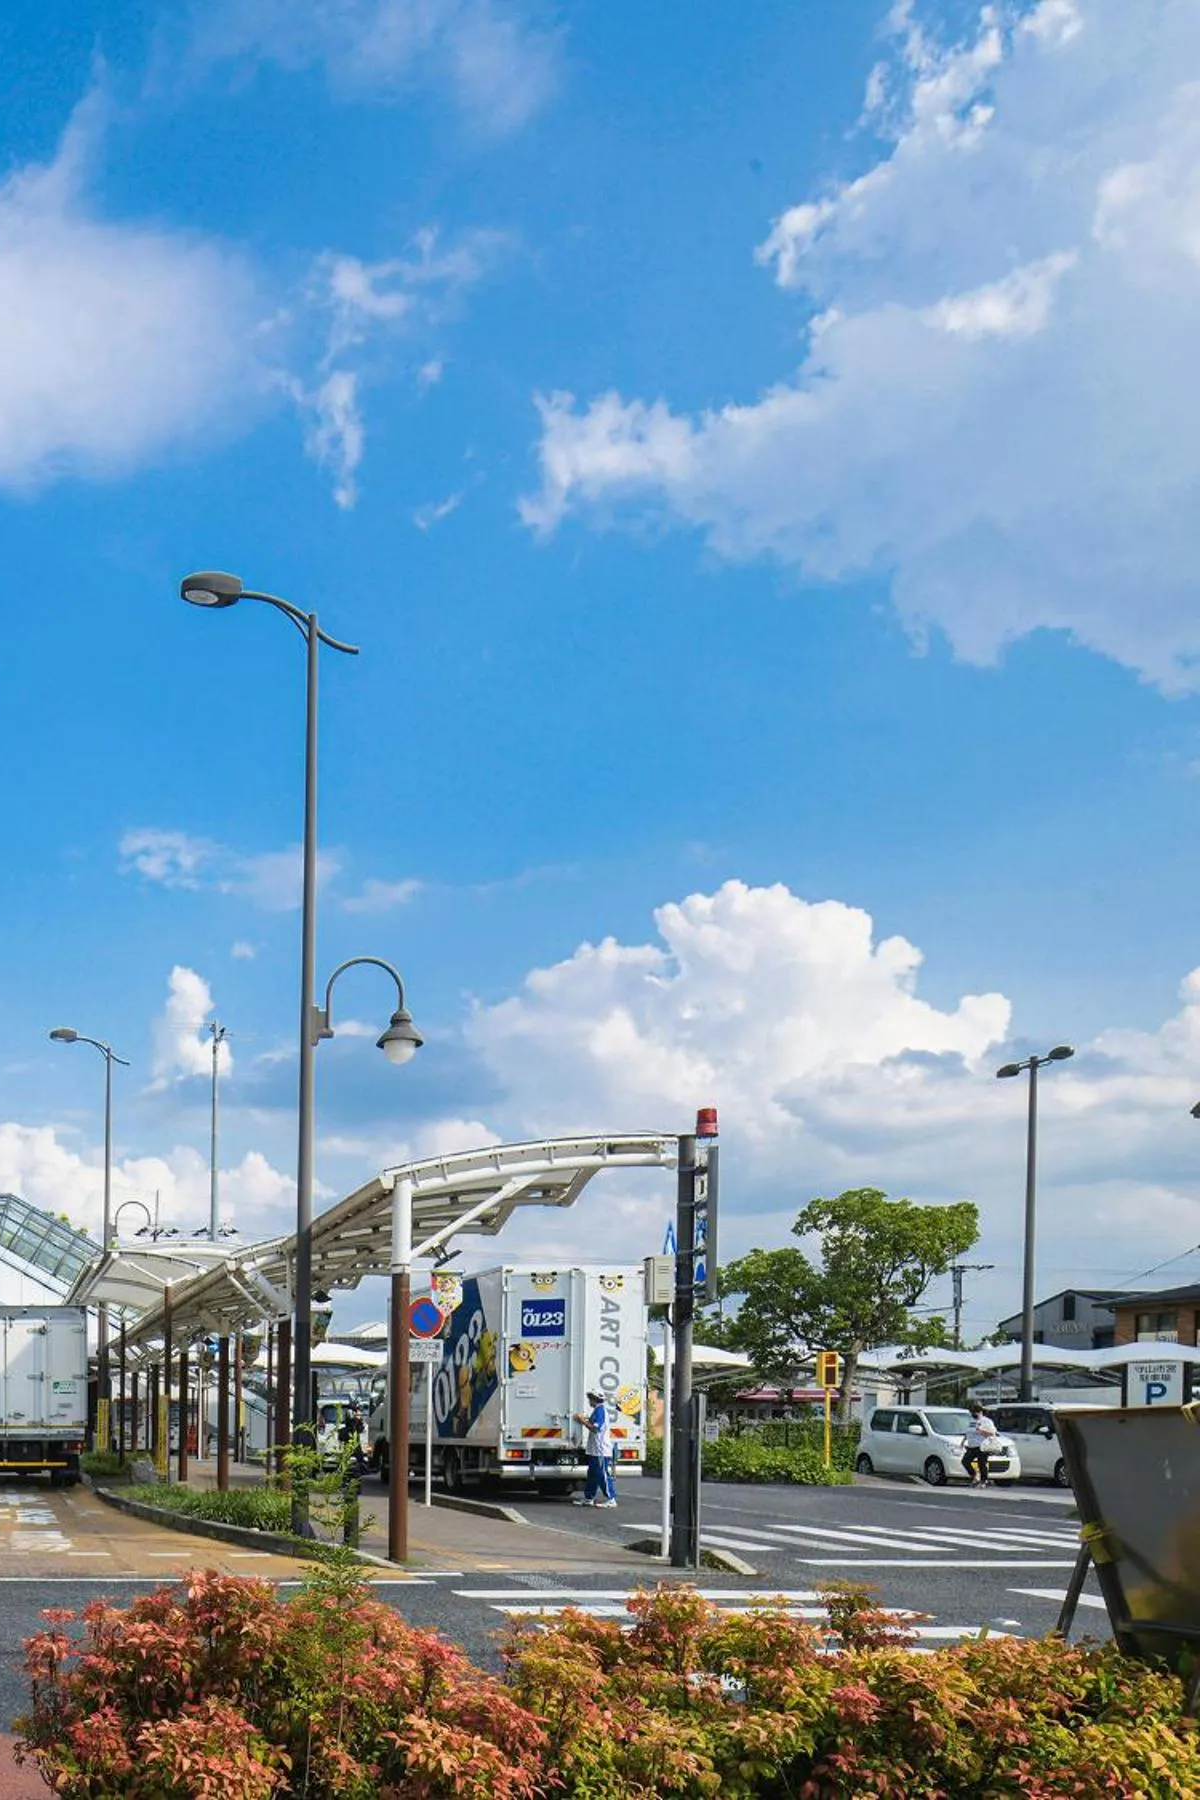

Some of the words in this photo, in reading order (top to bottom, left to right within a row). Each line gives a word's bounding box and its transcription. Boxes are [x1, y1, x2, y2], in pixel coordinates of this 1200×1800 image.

[523, 1312, 564, 1327] 0123
[600, 1296, 620, 1348] ART
[1146, 1383, 1167, 1405] P
